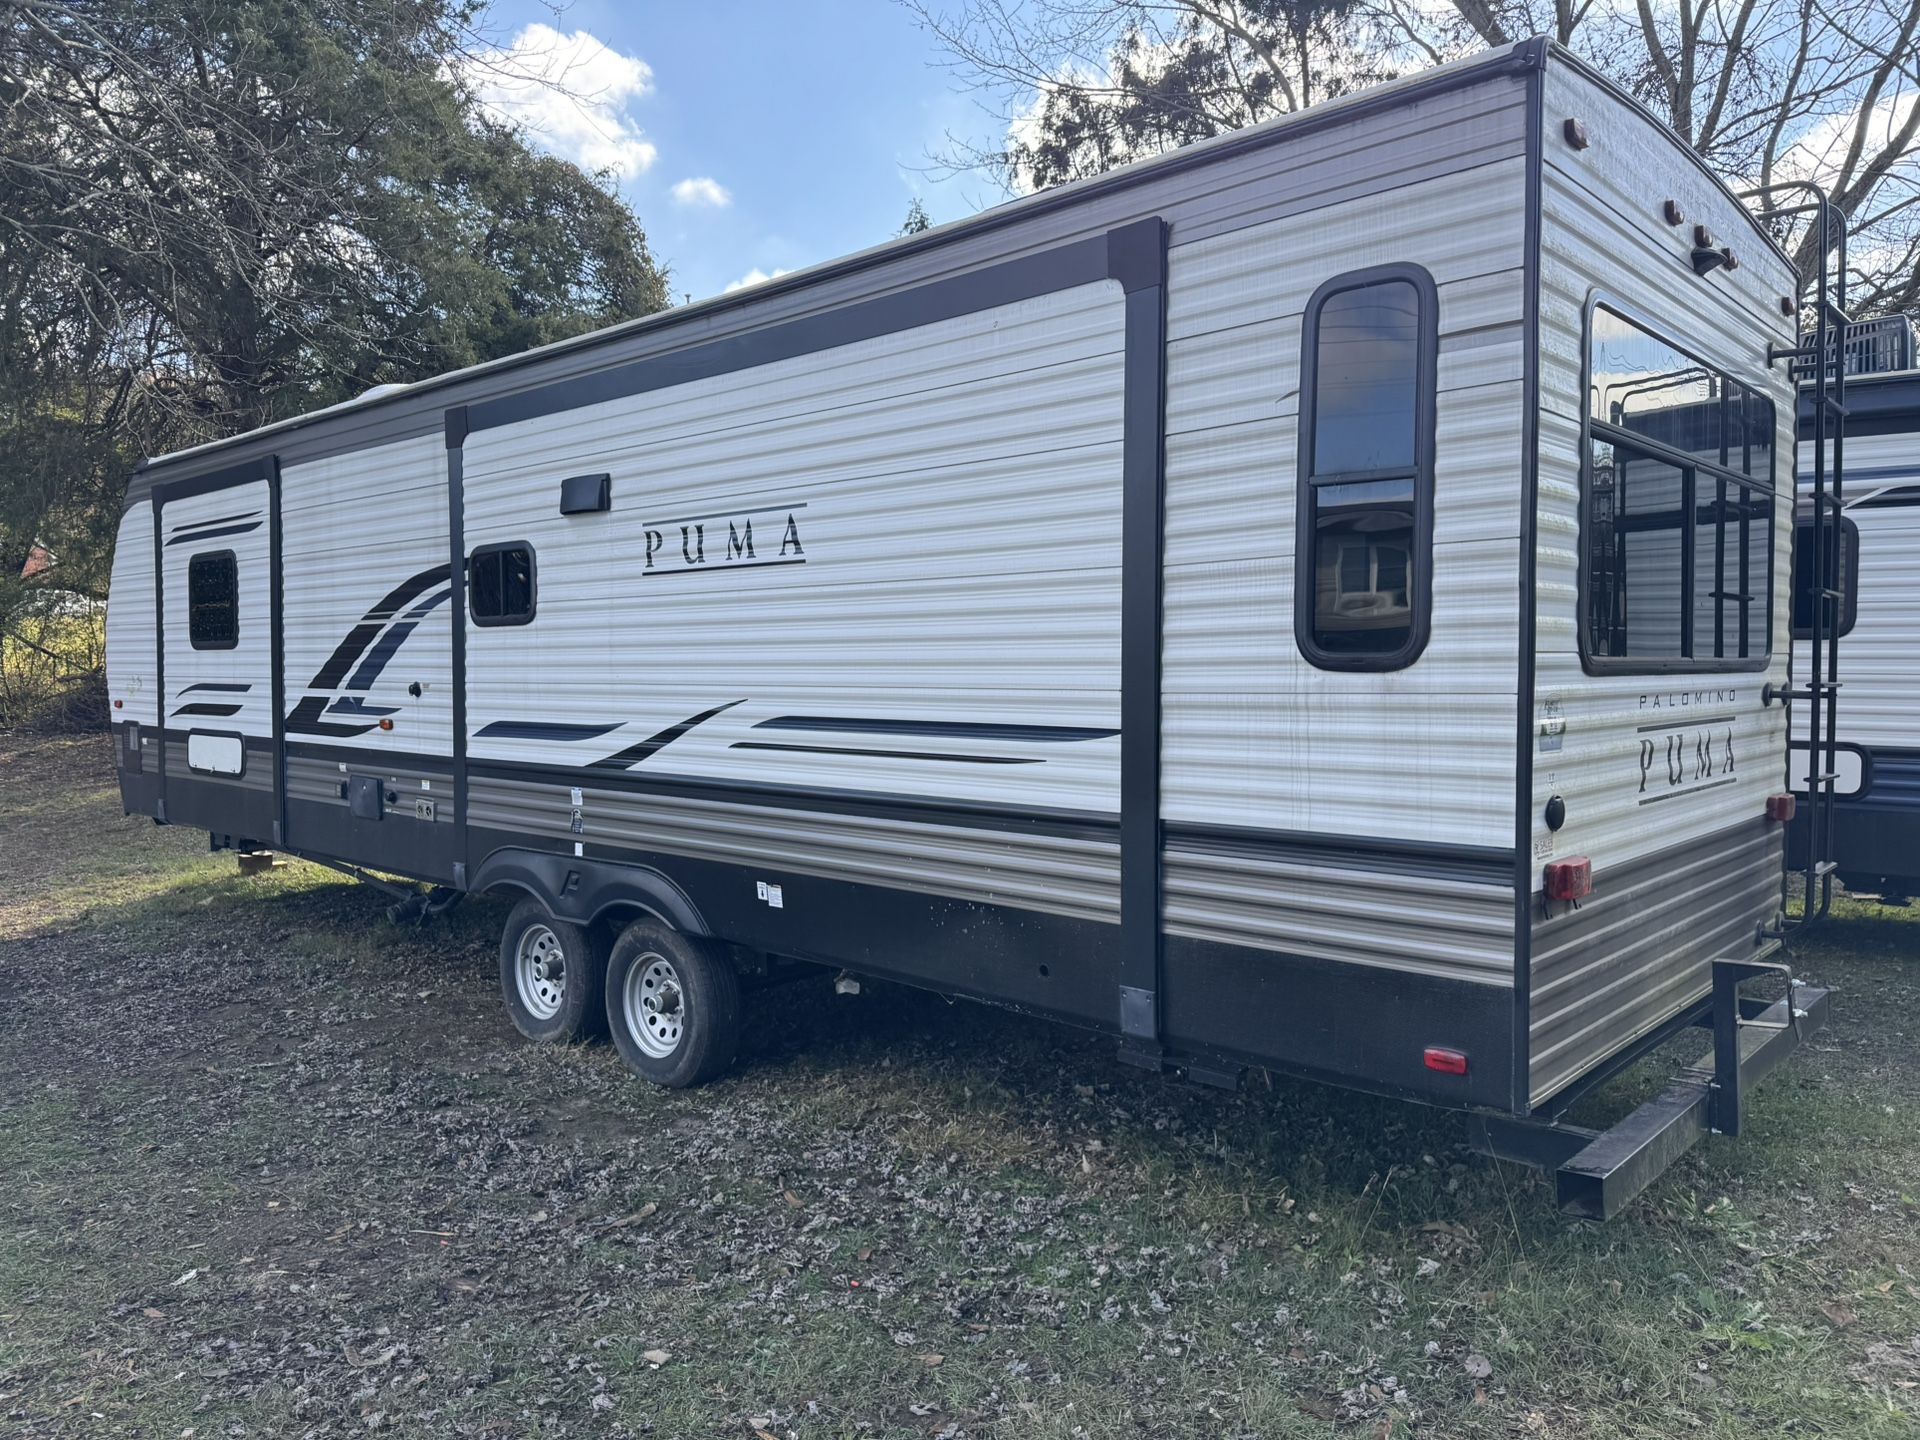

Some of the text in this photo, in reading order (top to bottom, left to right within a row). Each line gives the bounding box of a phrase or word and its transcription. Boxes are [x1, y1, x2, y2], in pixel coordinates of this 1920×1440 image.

[643, 513, 805, 568] PUMA
[1639, 689, 1736, 709] PALOMINO
[1638, 727, 1735, 793] PUMA
